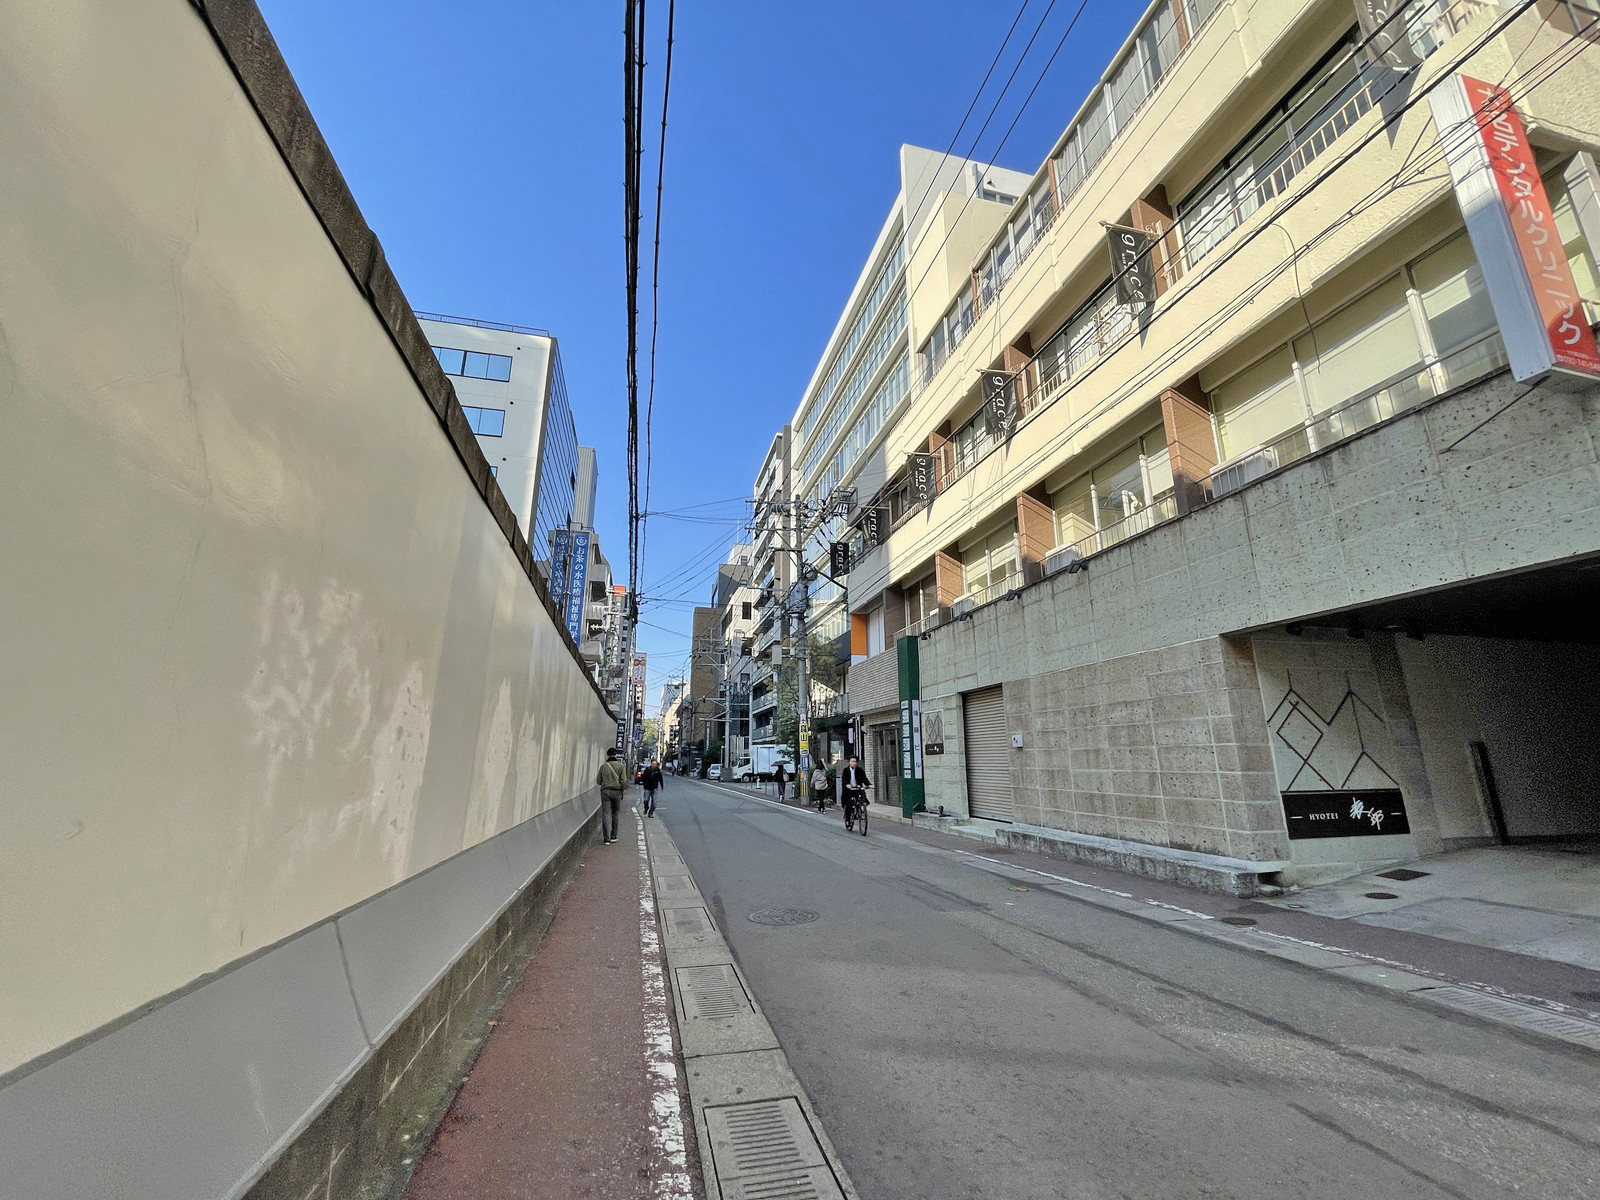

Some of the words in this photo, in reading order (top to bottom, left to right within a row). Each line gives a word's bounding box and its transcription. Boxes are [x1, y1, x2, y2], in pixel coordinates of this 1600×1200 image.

[1121, 233, 1145, 300] grace
[992, 376, 1008, 430] grace
[917, 457, 927, 500] grace
[869, 509, 878, 545] grace
[569, 546, 585, 644] お茶の水医療福祉専門学
[1309, 812, 1339, 821] HYOTEI
